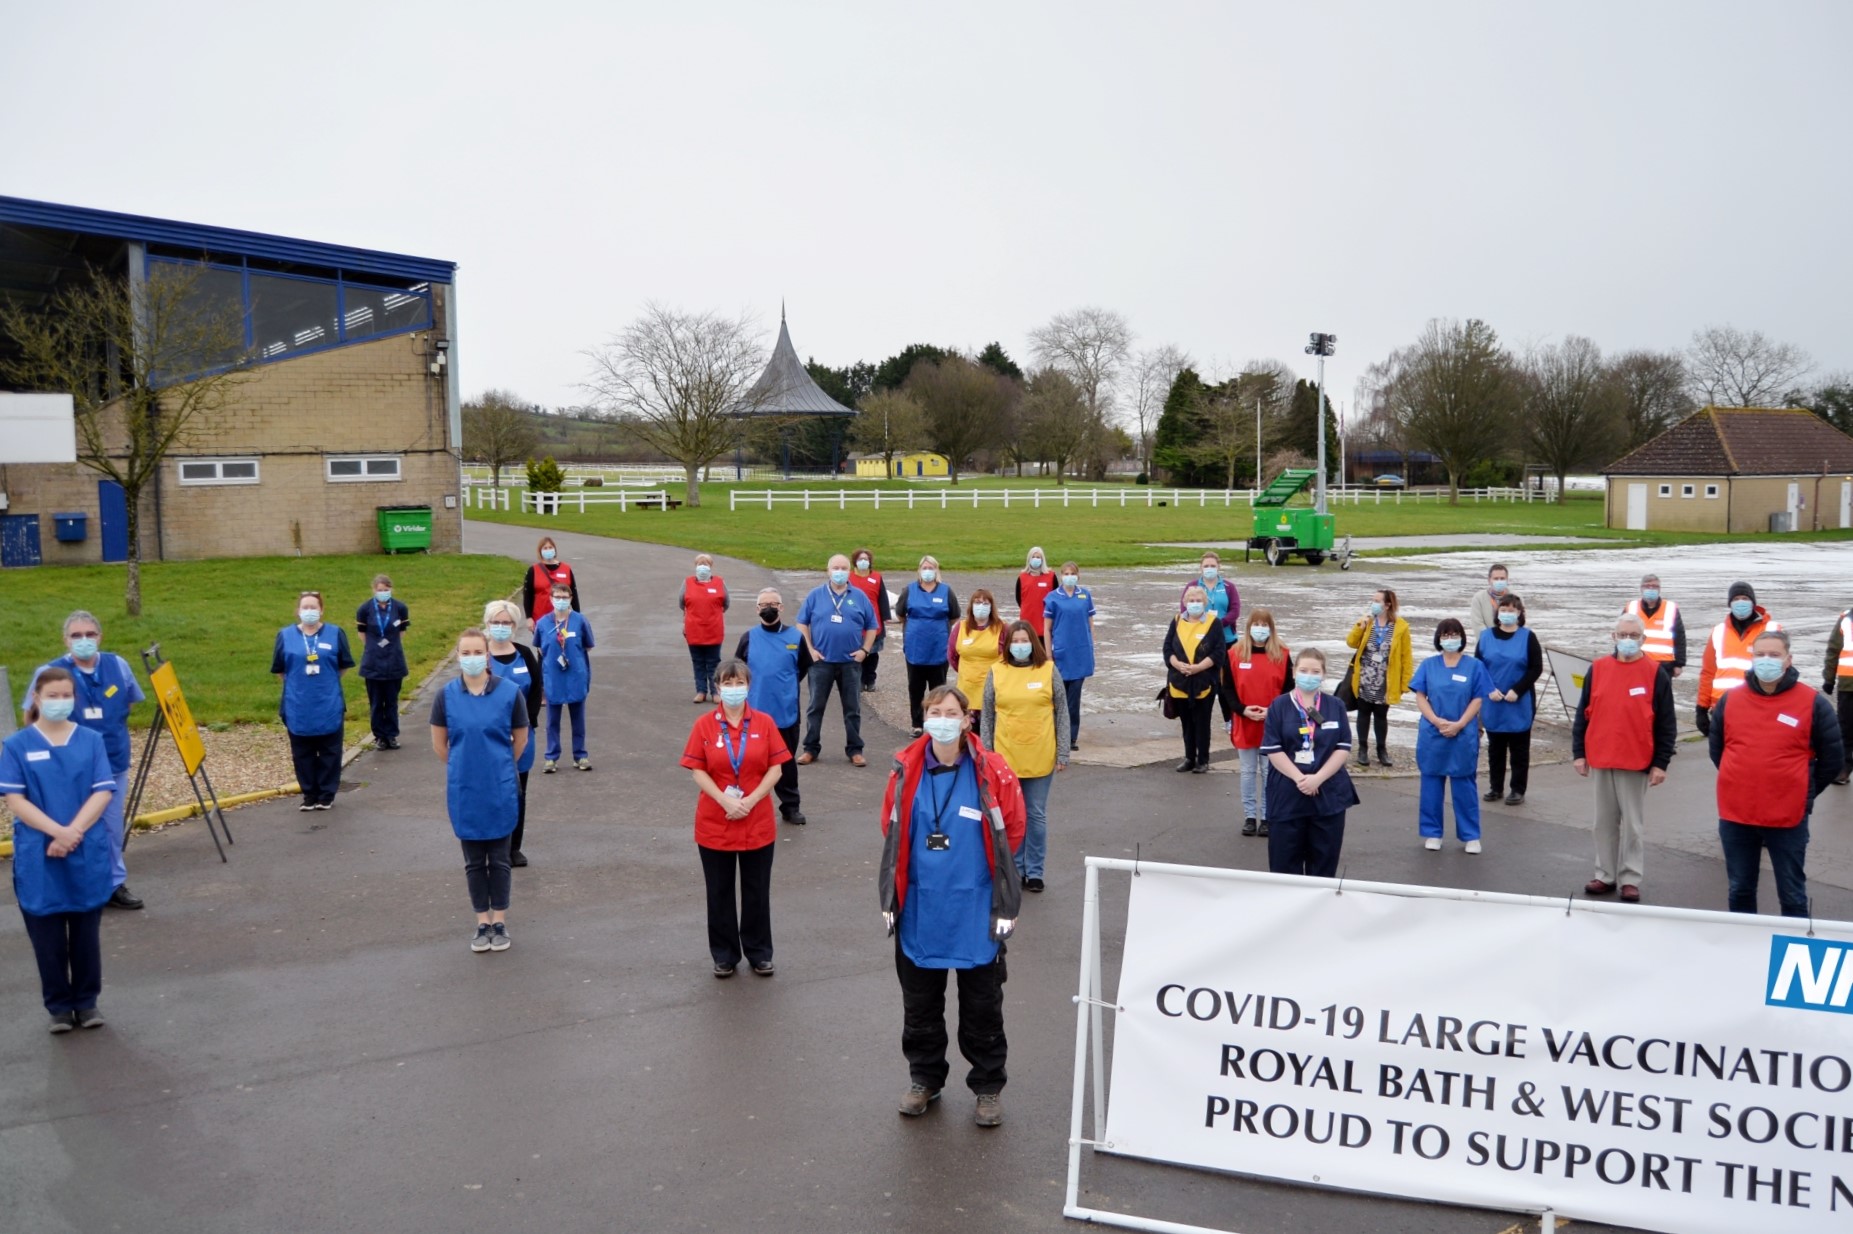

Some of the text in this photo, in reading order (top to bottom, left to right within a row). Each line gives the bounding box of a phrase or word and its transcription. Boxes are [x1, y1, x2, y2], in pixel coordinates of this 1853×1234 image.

[1157, 984, 1851, 1092] COVID-19 LARGE VACCINATIO
[1221, 1044, 1362, 1093] ROYAL
[1379, 1064, 1495, 1110] BATH
[1512, 1082, 1544, 1117] &
[1561, 1086, 1692, 1133] WEST
[1206, 1096, 1371, 1148] PROUD
[1387, 1120, 1450, 1159] TO
[1467, 1132, 1702, 1193] SUPPORT
[1716, 1162, 1811, 1208] THE
